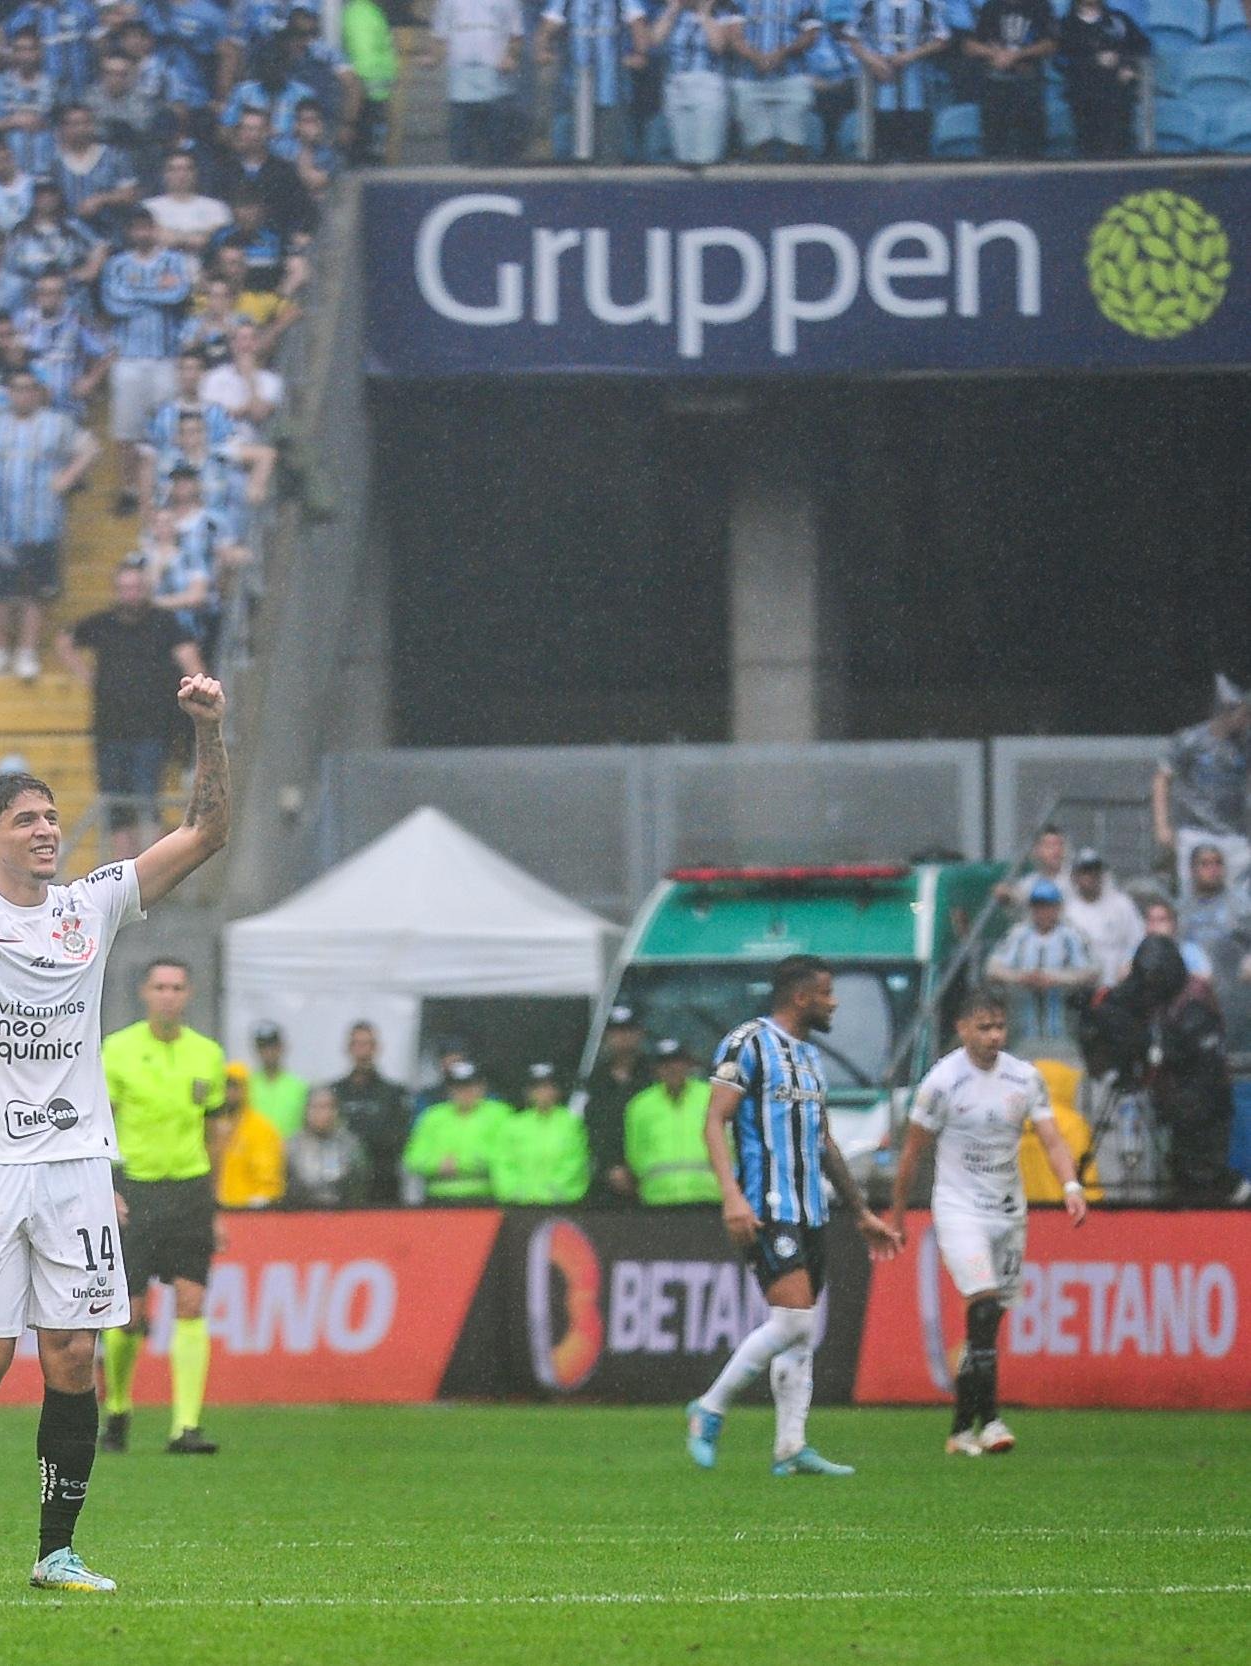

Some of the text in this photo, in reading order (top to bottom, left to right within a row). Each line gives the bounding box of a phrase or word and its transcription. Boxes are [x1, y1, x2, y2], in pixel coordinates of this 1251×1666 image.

[414, 192, 1042, 358] Gruppen
[94, 864, 123, 881] bmg
[13, 1110, 47, 1127] Tele
[76, 1225, 115, 1271] 14
[608, 1260, 828, 1353] BETA
[1010, 1262, 1238, 1357] BETANO
